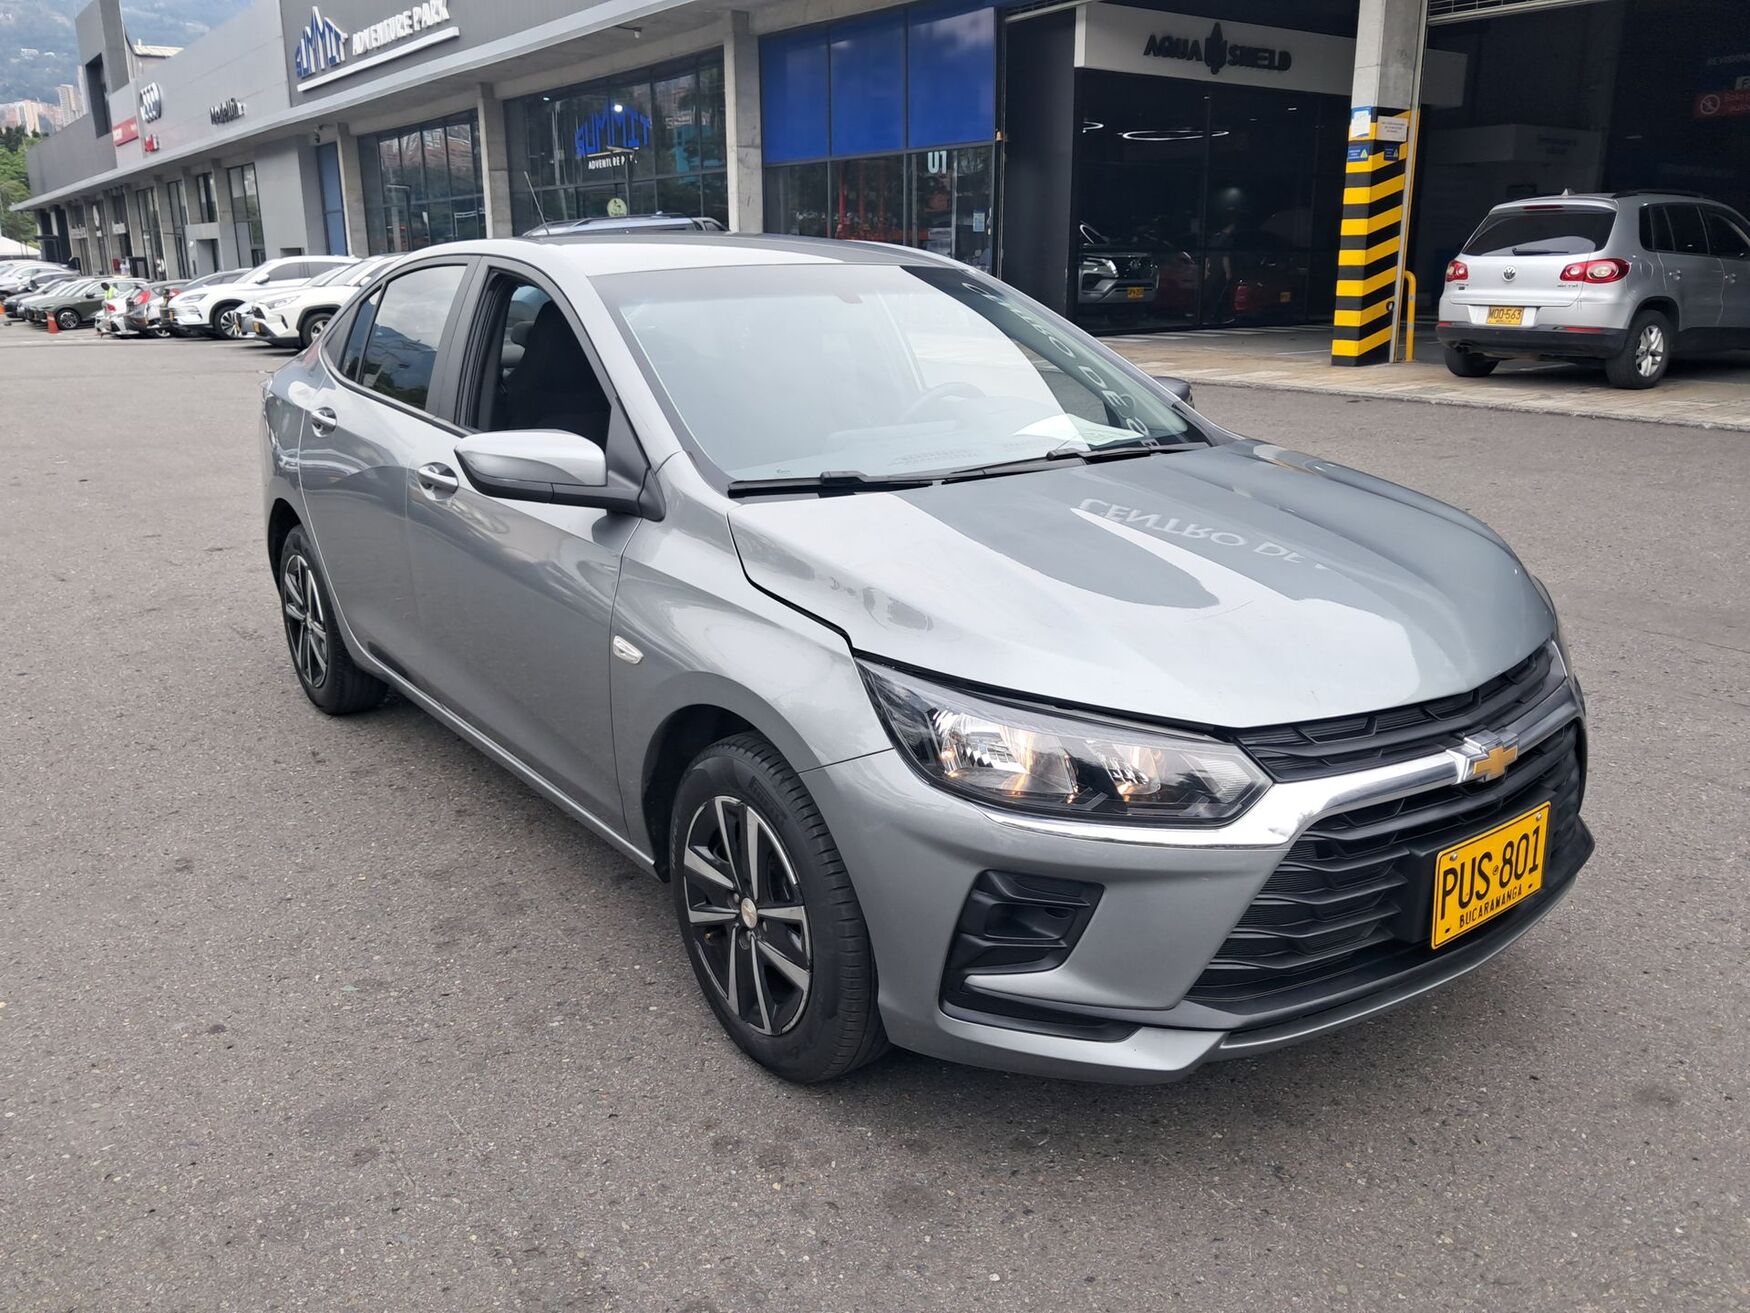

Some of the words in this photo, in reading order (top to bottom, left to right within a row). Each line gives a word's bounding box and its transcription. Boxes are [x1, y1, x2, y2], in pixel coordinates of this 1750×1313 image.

[412, 0, 450, 31] PARK
[1143, 34, 1203, 61] AQUA
[1227, 44, 1292, 71] SHIELD
[1440, 851, 1493, 921] PUS
[1499, 825, 1541, 889] 801
[1459, 883, 1523, 929] BUCARAMANGA
